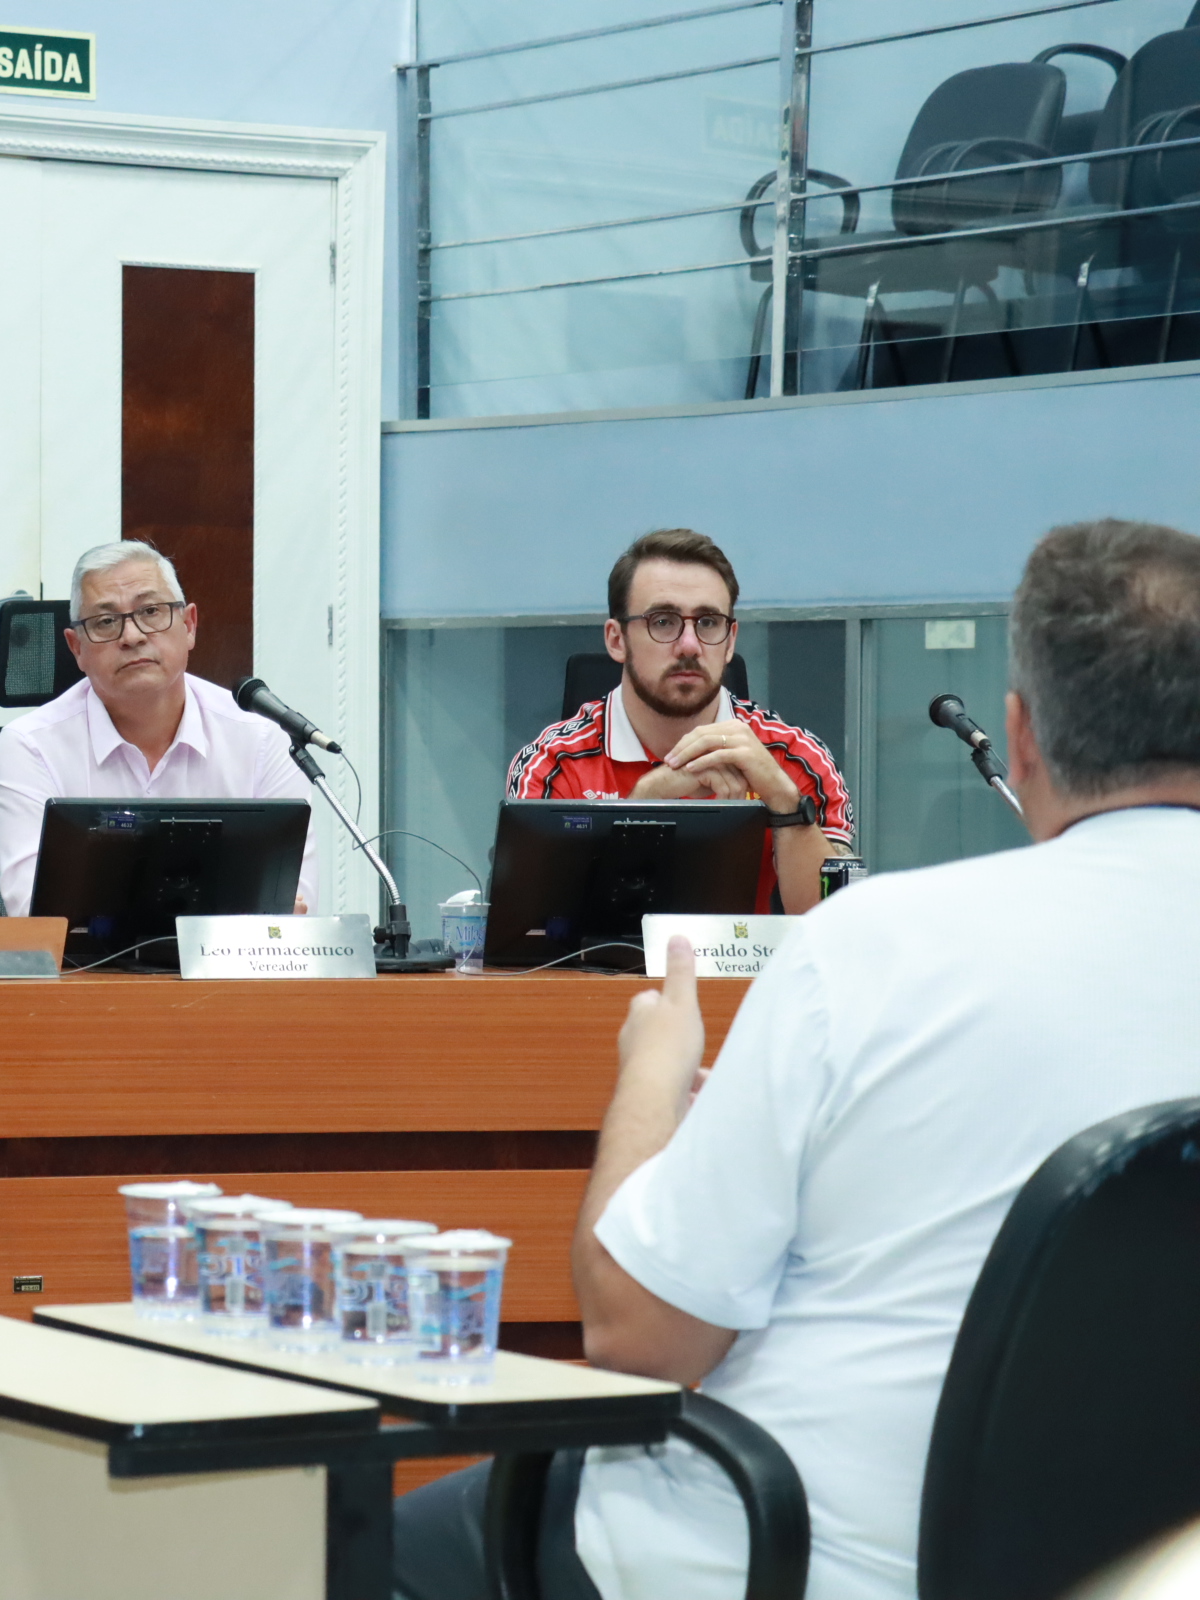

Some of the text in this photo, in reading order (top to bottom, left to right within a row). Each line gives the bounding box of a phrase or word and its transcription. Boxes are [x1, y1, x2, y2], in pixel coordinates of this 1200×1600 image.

[693, 943, 748, 957] eraldo
[249, 960, 308, 972] Vereador
[715, 961, 765, 973] Veread
